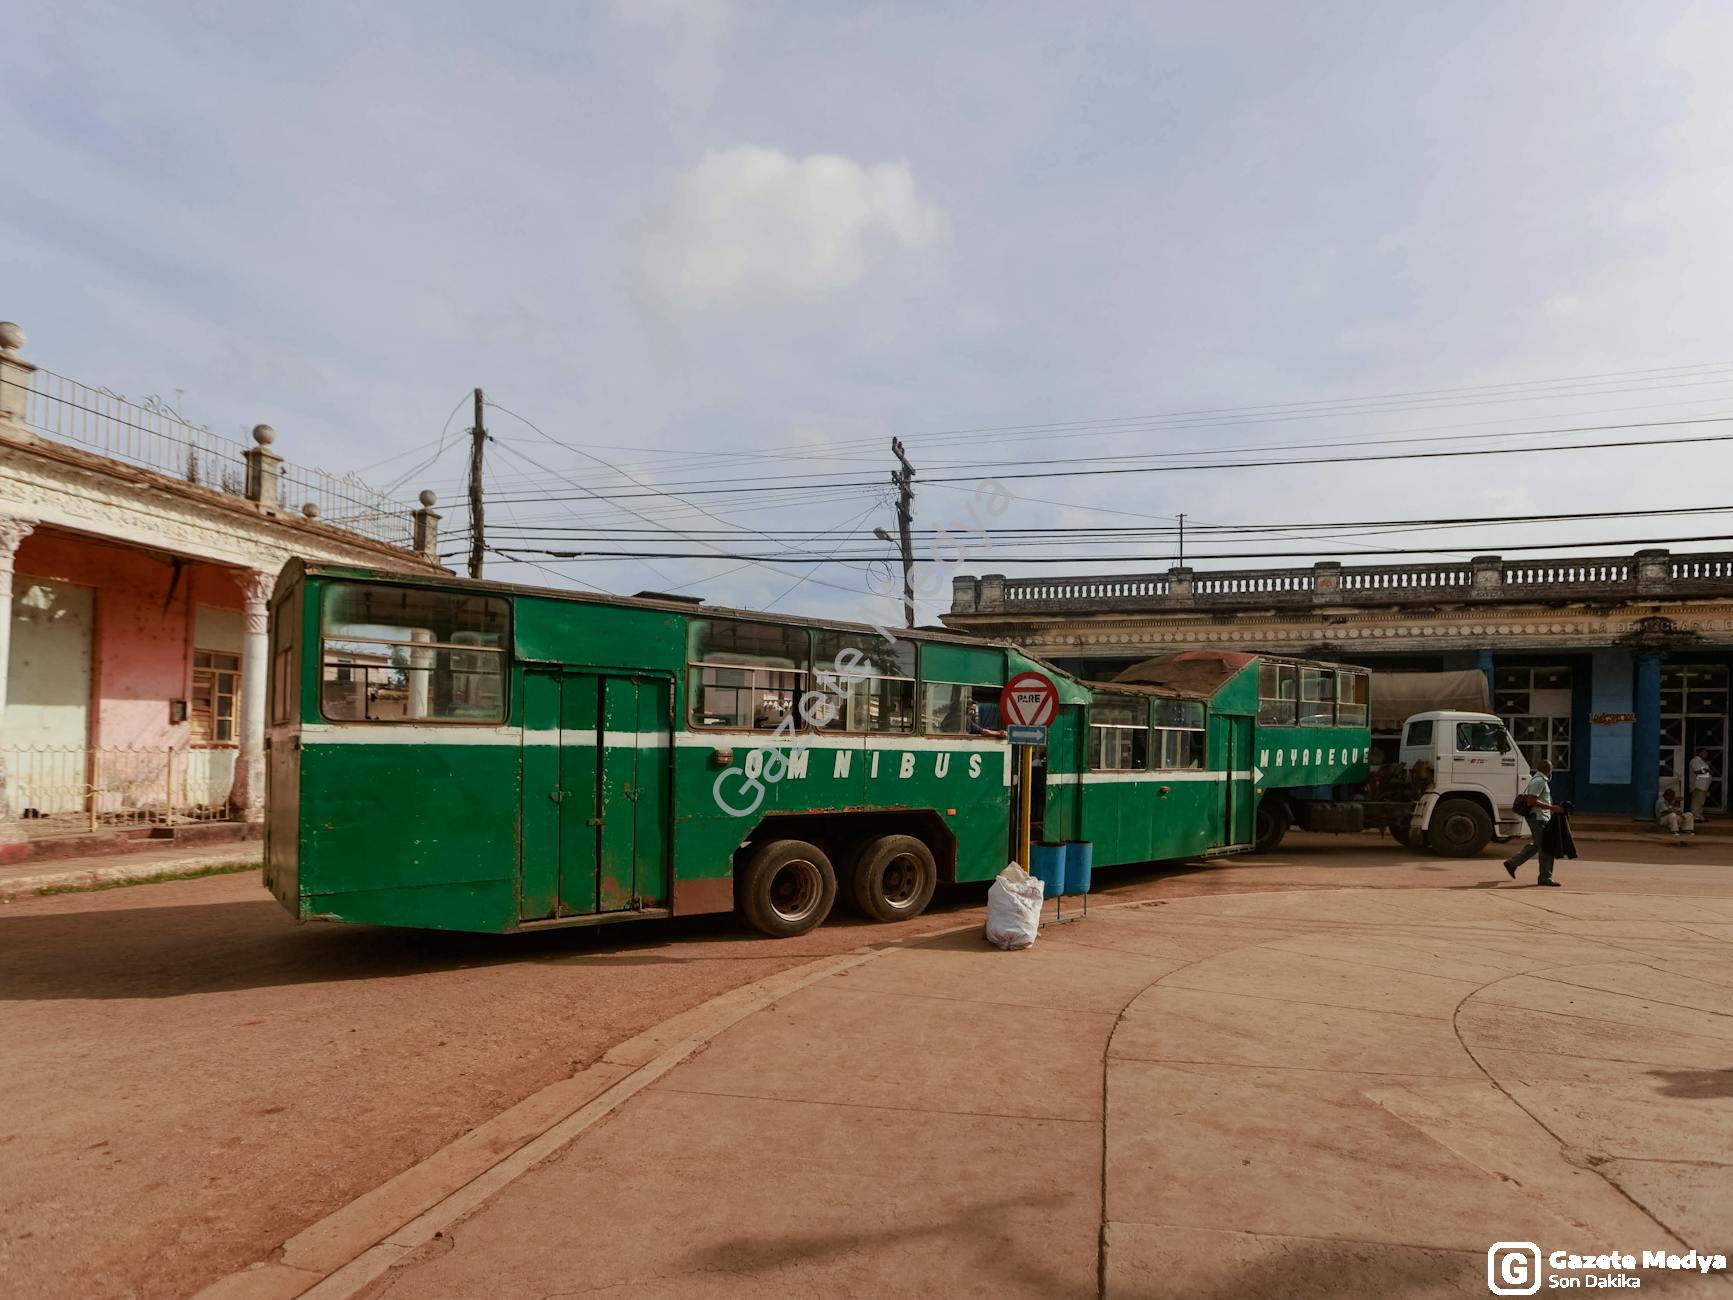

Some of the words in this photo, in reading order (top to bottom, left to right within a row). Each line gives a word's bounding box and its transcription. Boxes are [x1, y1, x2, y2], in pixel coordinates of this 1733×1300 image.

[1017, 694, 1041, 703] PARE
[744, 749, 983, 780] OMNIBUS
[1259, 747, 1370, 768] MAYABEQUE
